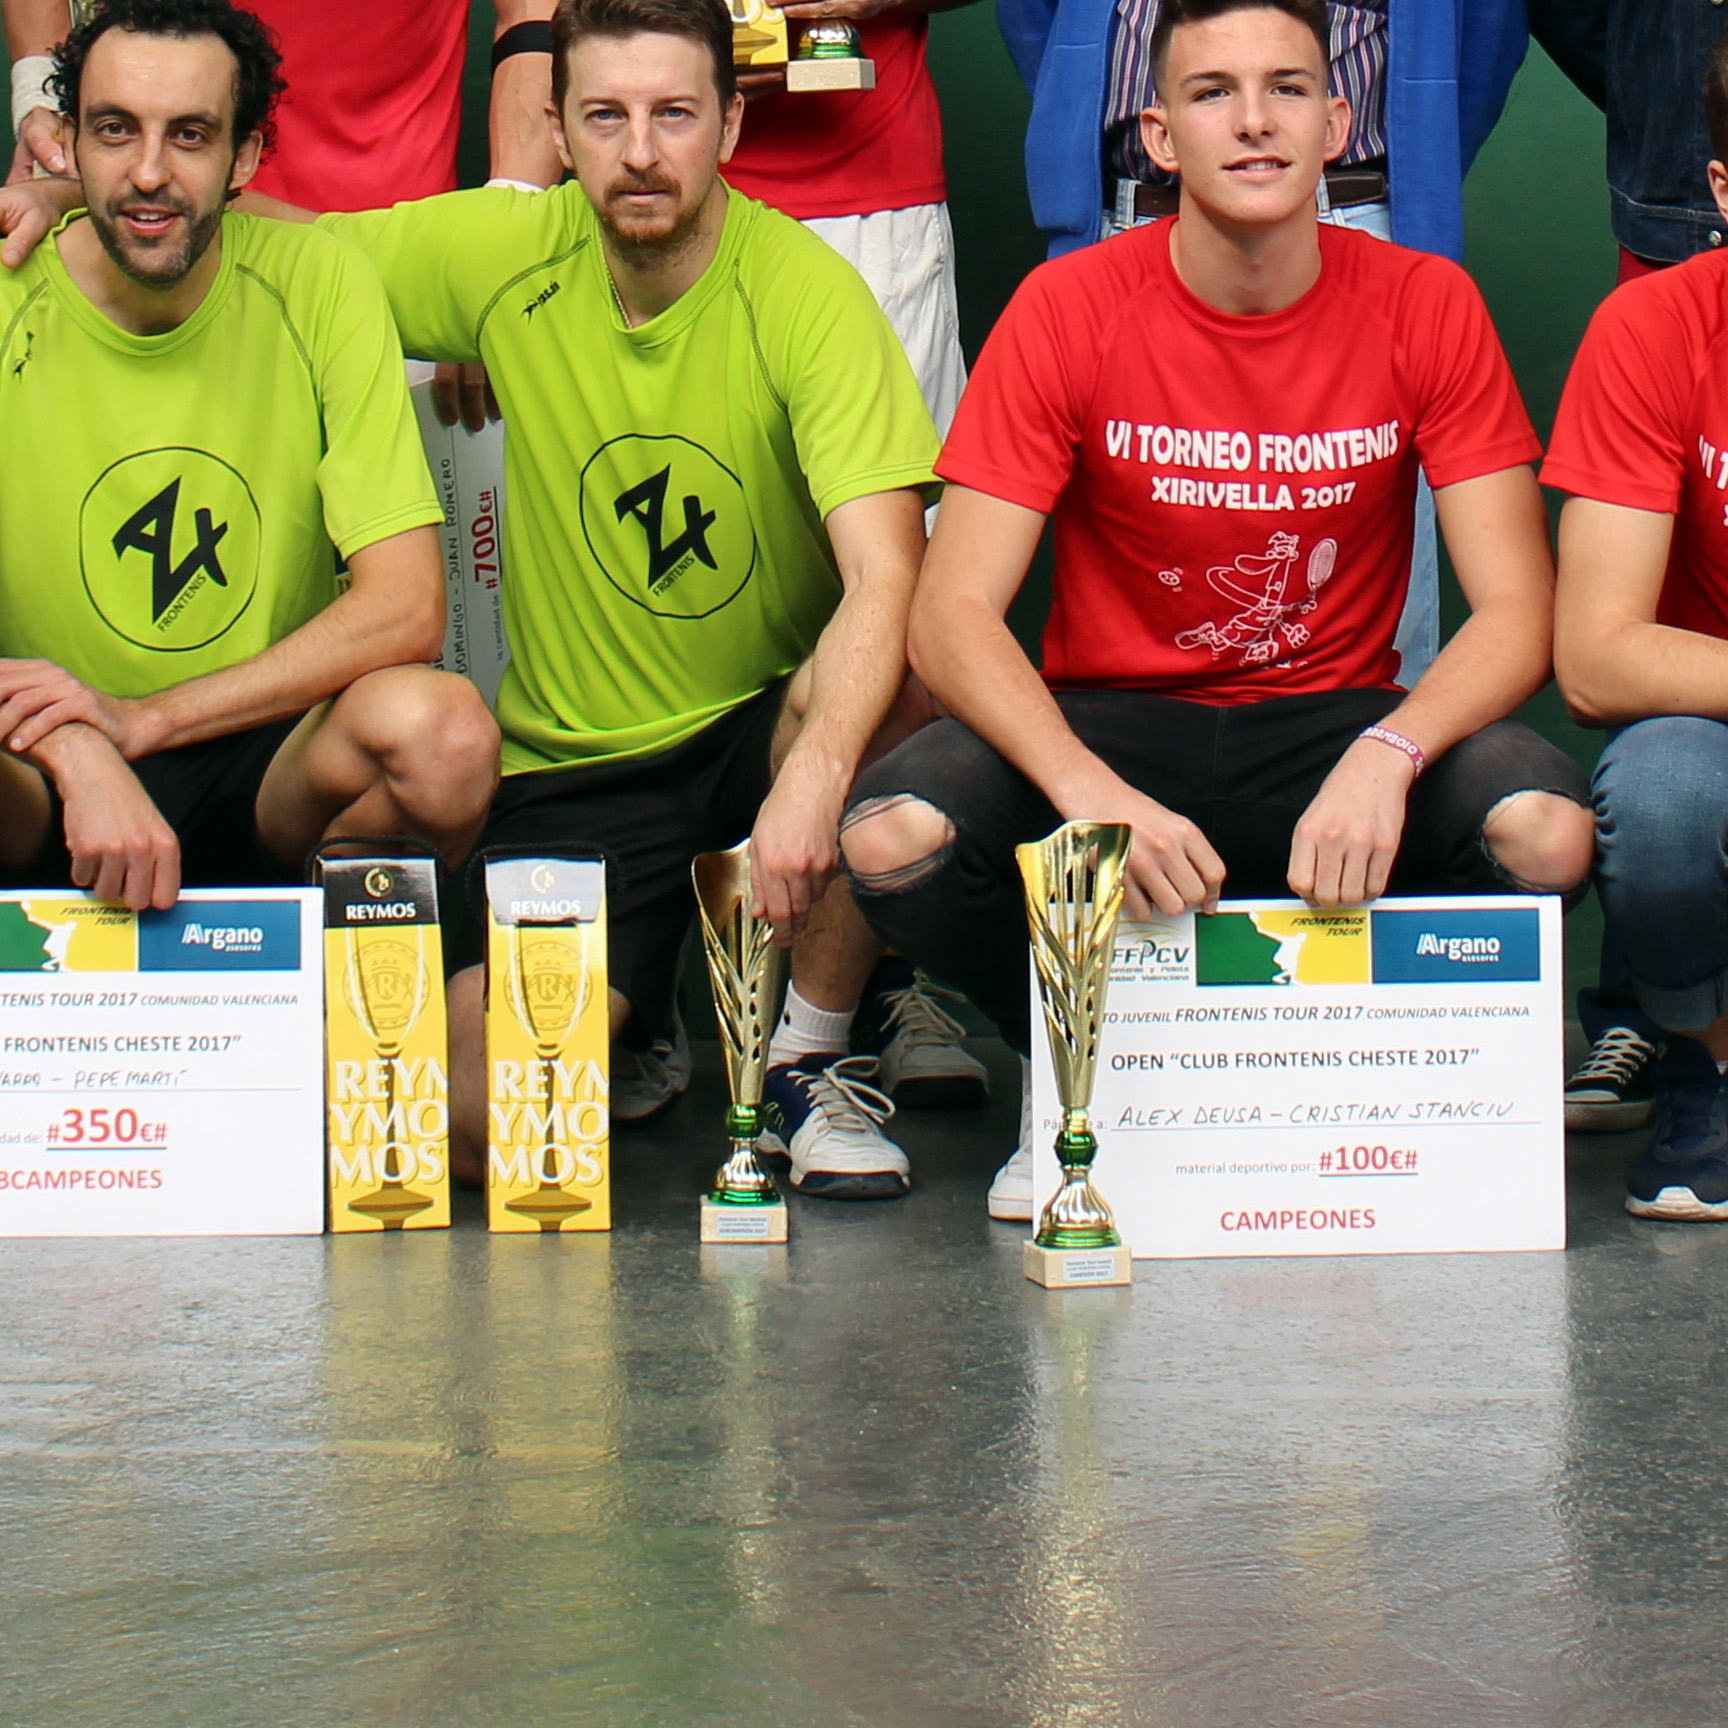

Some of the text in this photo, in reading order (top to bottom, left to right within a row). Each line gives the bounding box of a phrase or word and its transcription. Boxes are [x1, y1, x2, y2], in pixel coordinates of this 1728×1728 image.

[1105, 420, 1399, 473] VI TORNEO FRONTENIS
[440, 458, 458, 527] ROMERO
[1151, 476, 1357, 511] XIRIVELLA 2017
[471, 489, 499, 590] #700€#
[448, 537, 462, 581] JUAN
[653, 555, 695, 597] FRONTENIS
[156, 573, 207, 632] FRONTENIS
[95, 917, 131, 927] TOUR
[345, 903, 416, 920] REYMOS
[510, 900, 581, 917] REYMOS
[1290, 915, 1365, 926] FRONTENIS
[181, 923, 263, 952] Argano
[1327, 927, 1363, 937] TOUR
[1112, 939, 1190, 967] FFPCV
[1416, 933, 1501, 962] Argano
[50, 993, 93, 1007] TOUR
[99, 993, 138, 1007] 2017
[140, 995, 219, 1007] COMUNIDAD
[222, 995, 299, 1006] VALENCIANA
[1121, 1012, 1171, 1024] JUVENIL
[1175, 1008, 1268, 1023] FRONTENIS
[1273, 1007, 1319, 1022] TOUR
[1323, 1006, 1364, 1021] 2017
[1367, 1008, 1447, 1020] COMUNIDAD
[1451, 1006, 1530, 1018] VALENCIANA
[4, 1036, 109, 1053] FRONTENIS
[114, 1035, 183, 1052] CHESTE
[1111, 1053, 1164, 1071] OPEN
[1235, 1051, 1343, 1068] FRONTENIS
[1349, 1050, 1418, 1067] CHESTE
[73, 1070, 122, 1090] PEPE
[46, 1107, 168, 1144] #350€#
[1118, 1100, 1515, 1128] ALEX DEUSA CRISTIAN STANCIU
[1176, 1145, 1419, 1177] material deportivo por: #100€#
[1220, 1209, 1376, 1232] CAMPEONES
